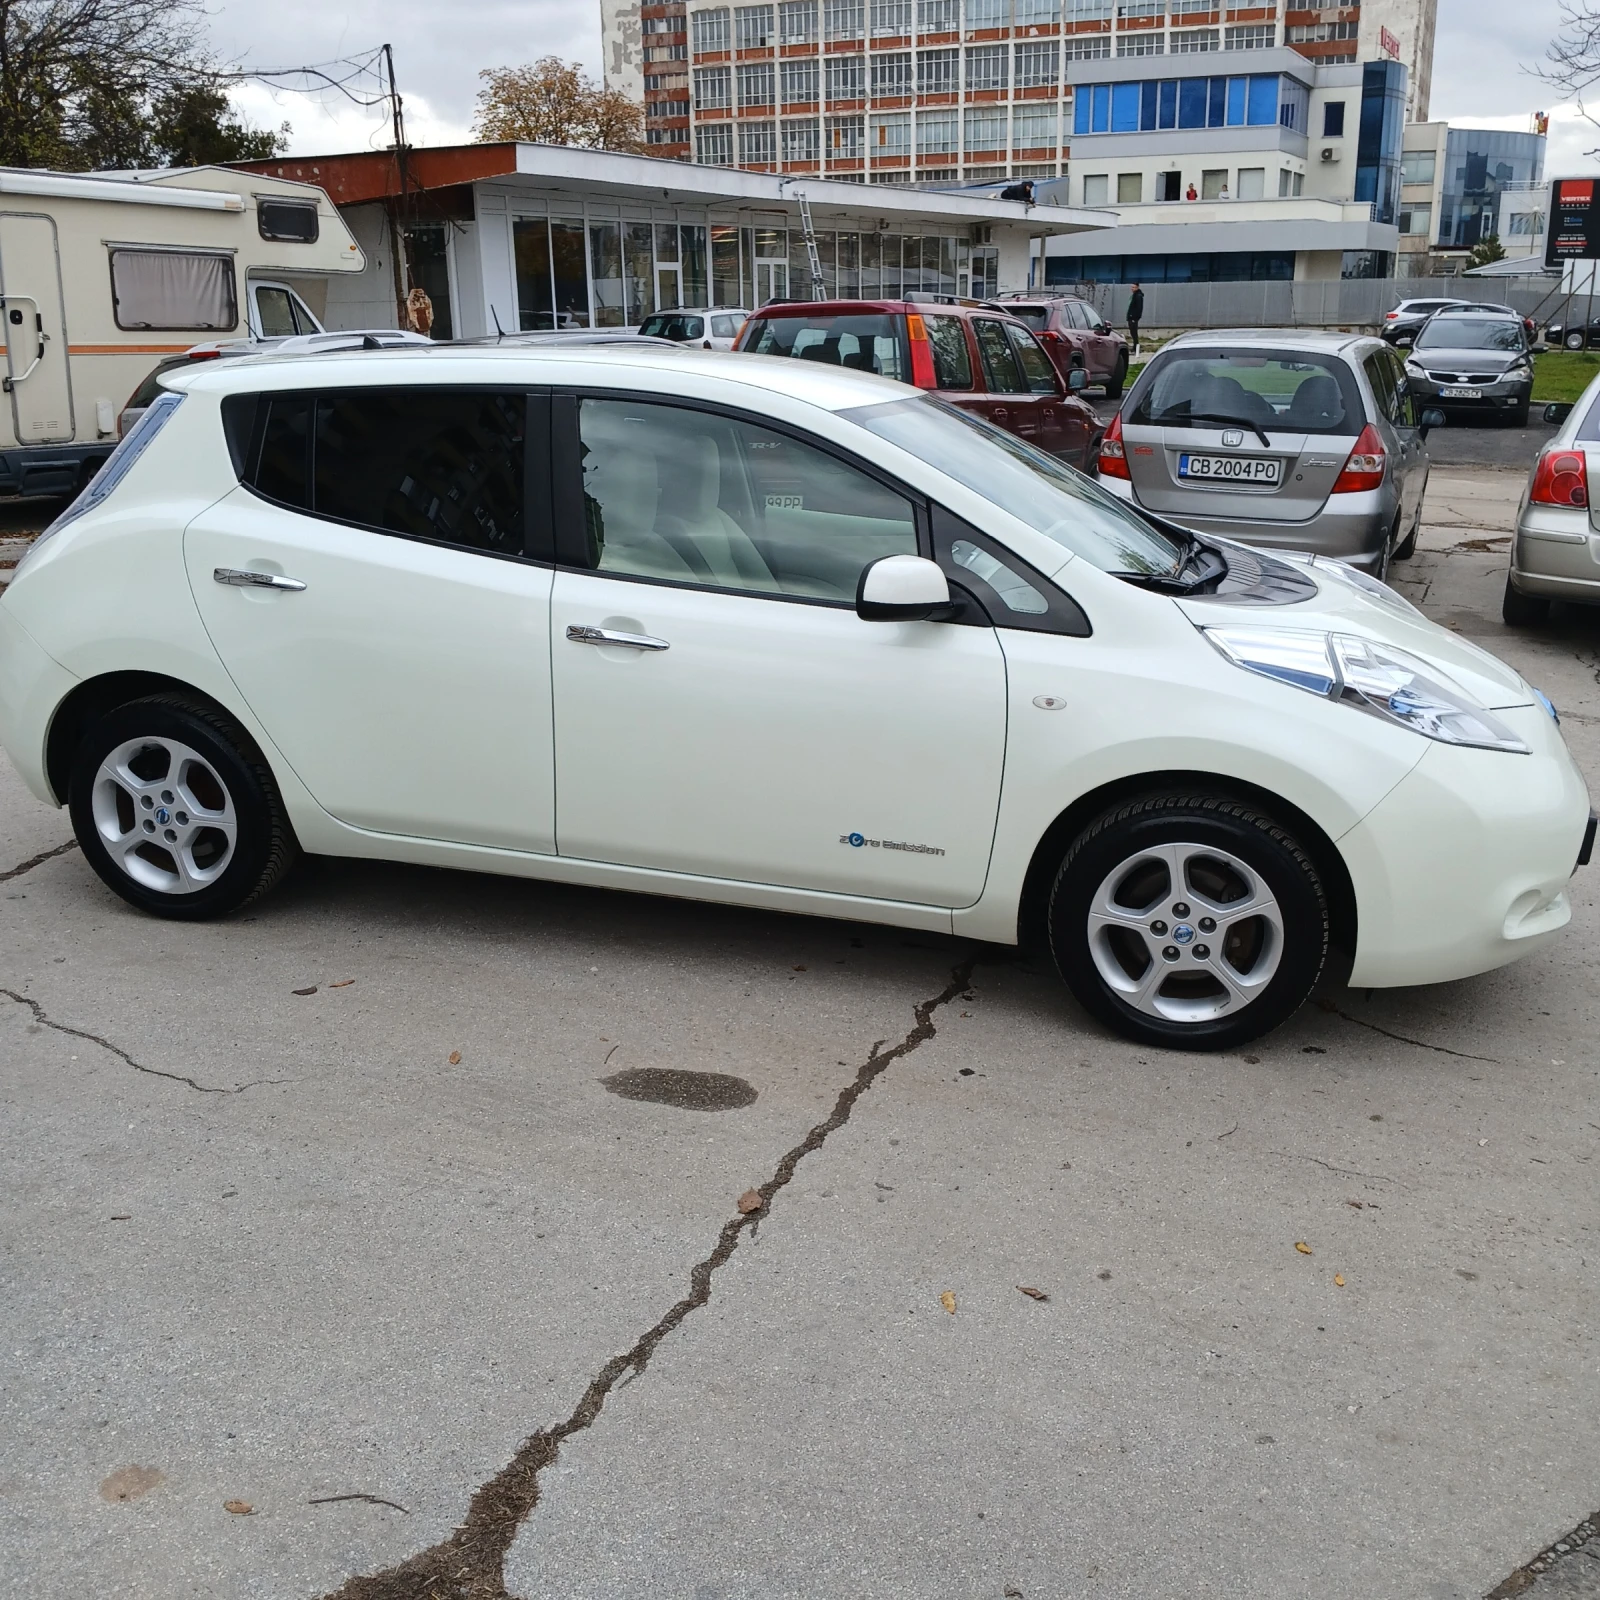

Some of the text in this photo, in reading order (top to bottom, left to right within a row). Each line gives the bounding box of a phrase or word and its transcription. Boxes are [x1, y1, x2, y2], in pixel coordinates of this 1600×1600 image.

[1190, 458, 1211, 474] CB
[1213, 460, 1252, 477] 2004
[784, 497, 800, 509] PP
[882, 839, 945, 856] Emission
